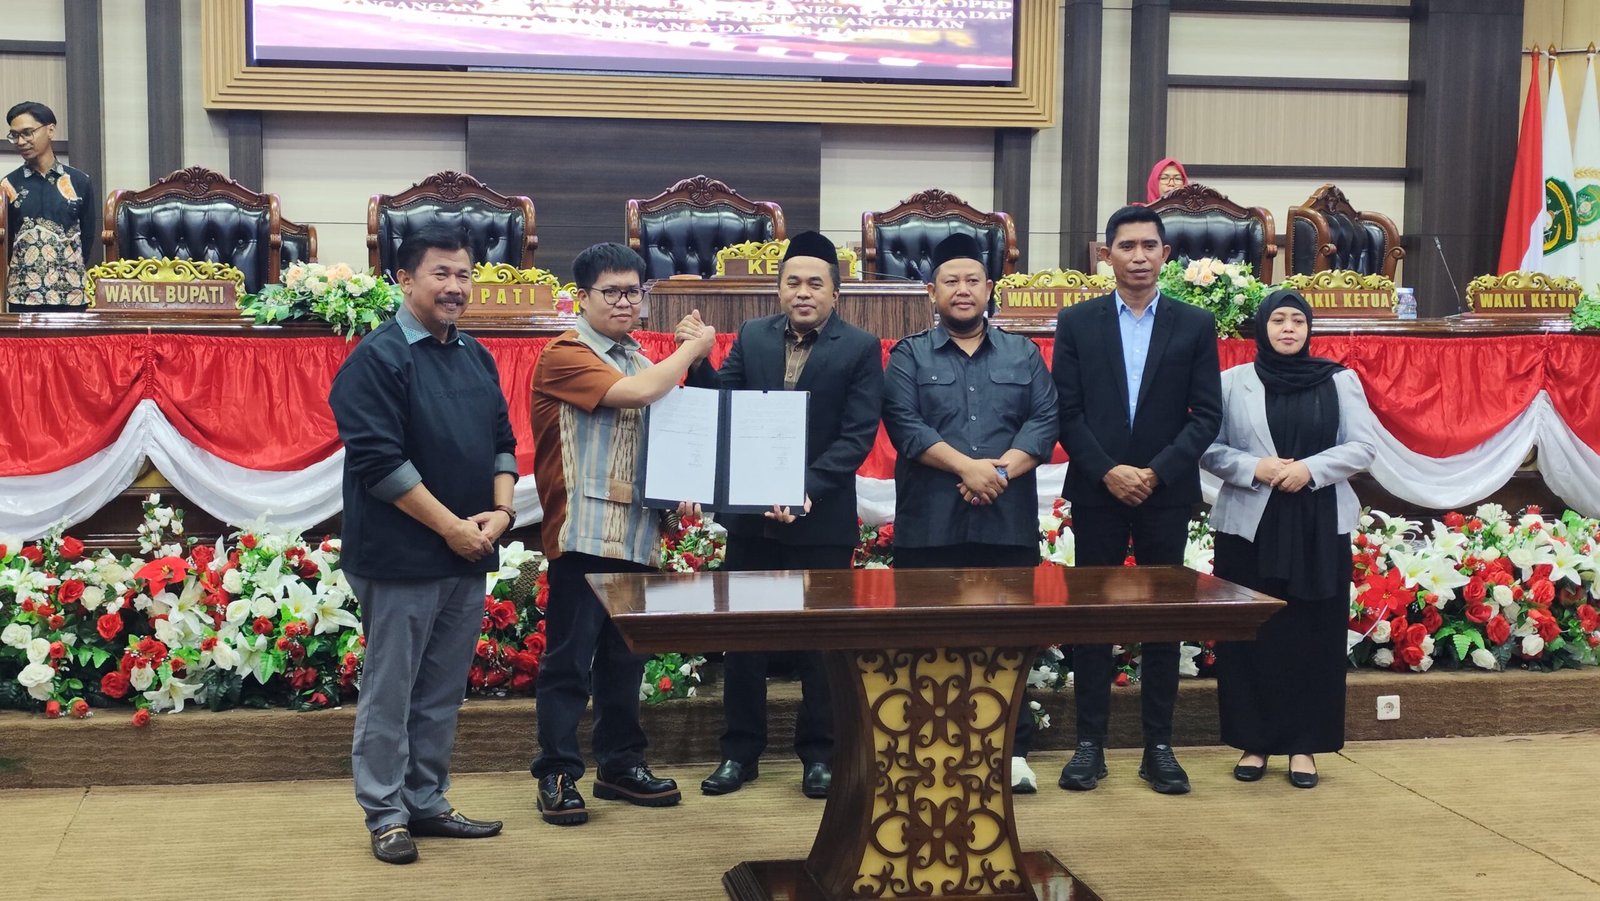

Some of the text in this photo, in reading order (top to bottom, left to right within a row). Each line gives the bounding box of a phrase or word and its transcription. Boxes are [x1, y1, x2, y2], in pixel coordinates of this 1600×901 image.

[893, 8, 1013, 20] TERHADAP
[841, 17, 966, 29] ANGGARAN
[104, 285, 225, 304] WAKIL BUPATI
[468, 288, 536, 305] PATI
[1007, 291, 1058, 308] WAKIL
[1301, 293, 1390, 308] AKIL KETUA
[1479, 293, 1577, 308] WAKIL KETUA
